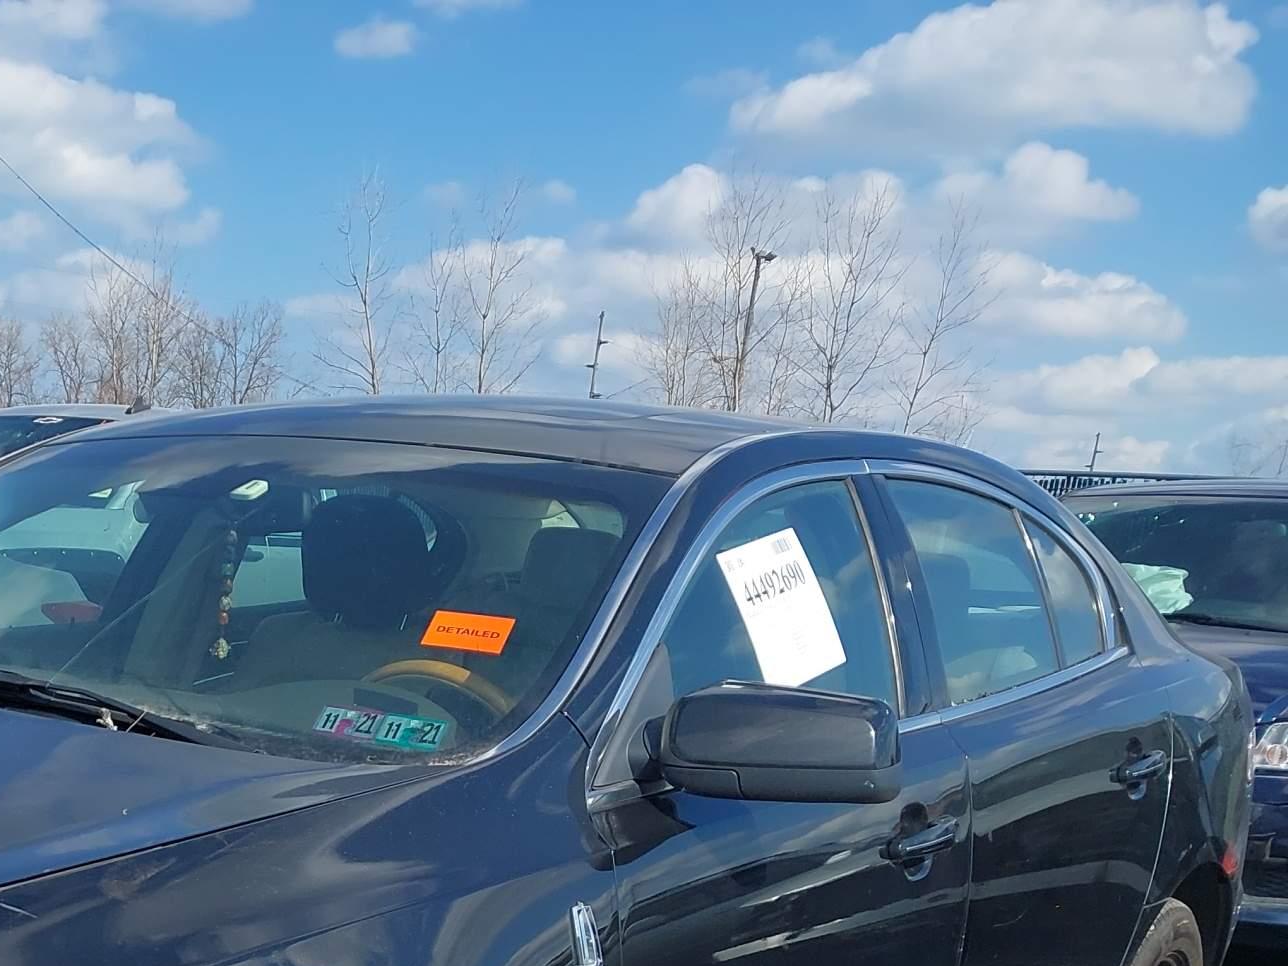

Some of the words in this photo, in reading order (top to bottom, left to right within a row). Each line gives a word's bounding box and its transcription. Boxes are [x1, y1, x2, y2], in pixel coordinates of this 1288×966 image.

[744, 560, 806, 607] 44492690
[435, 624, 501, 640] DETAILED
[322, 712, 340, 730] 11
[355, 713, 379, 734] 21
[384, 721, 403, 740] 11
[419, 722, 442, 745] 21
